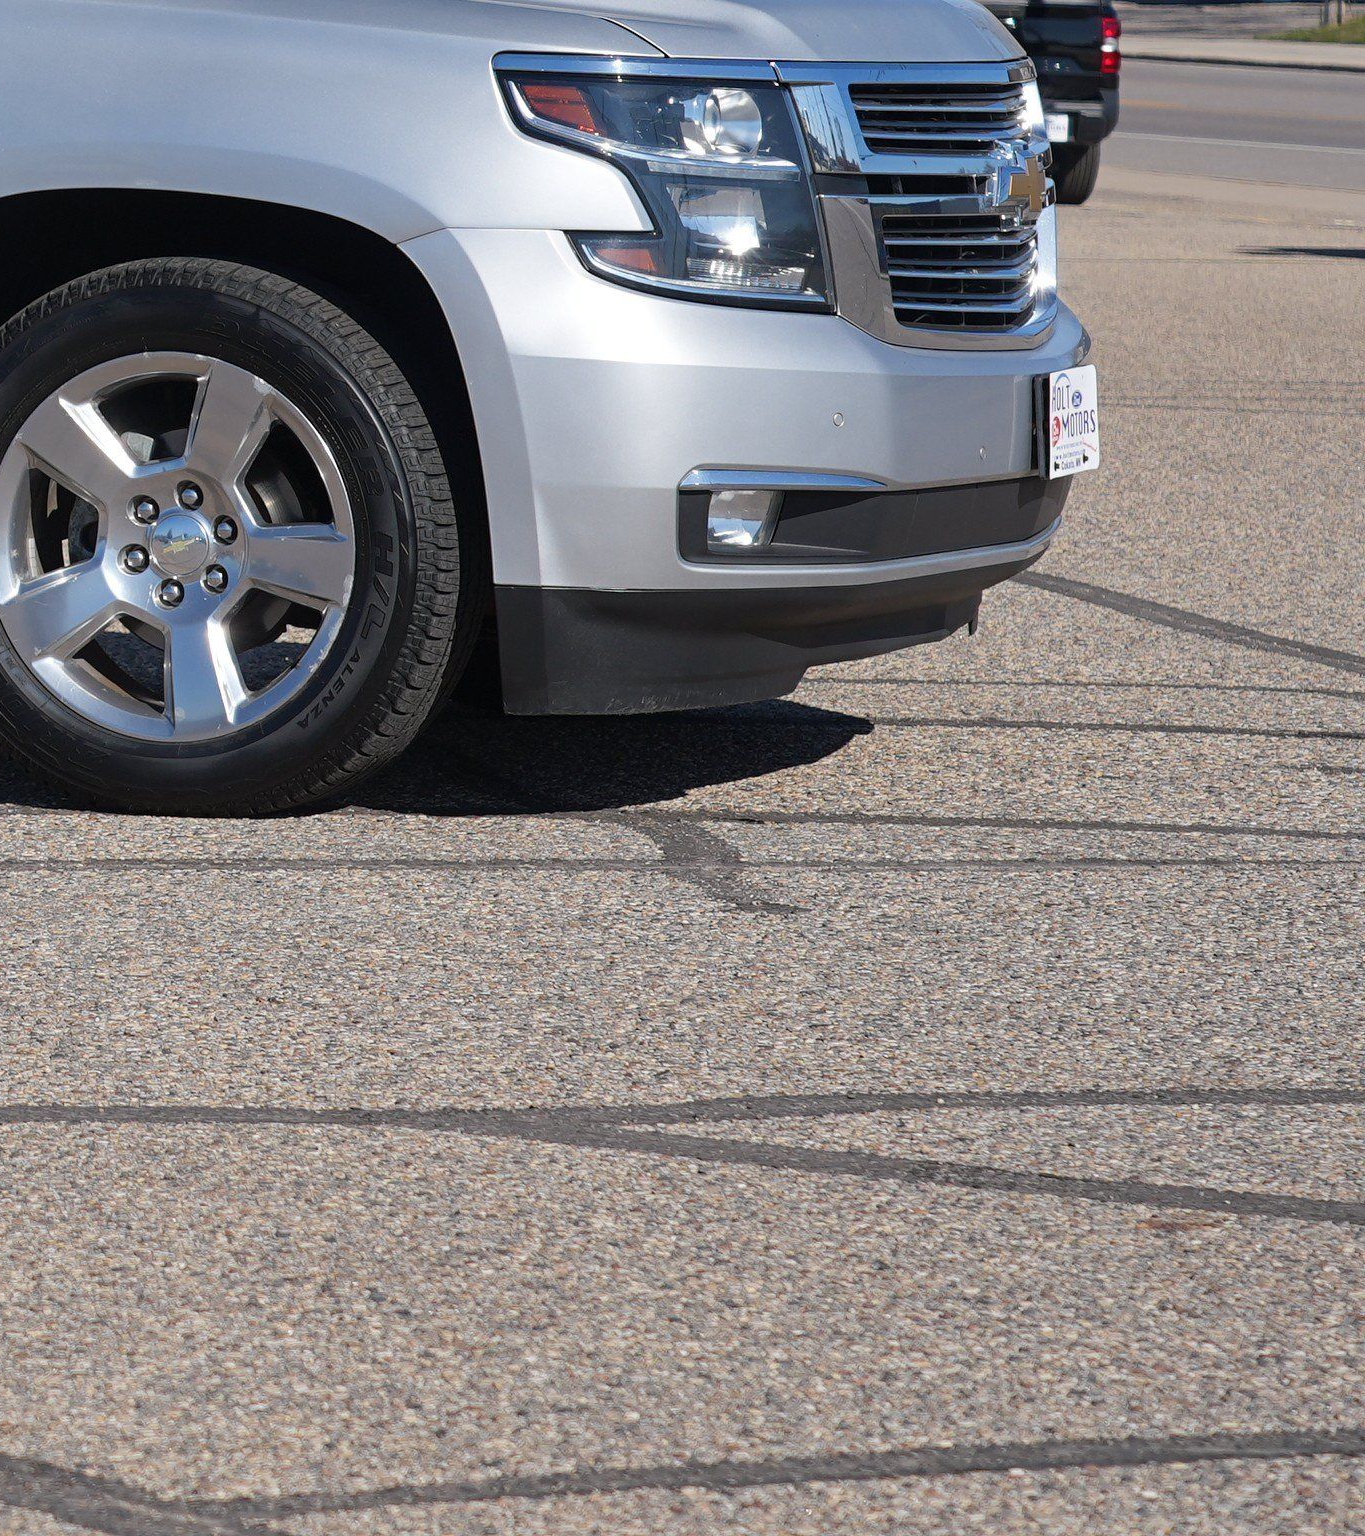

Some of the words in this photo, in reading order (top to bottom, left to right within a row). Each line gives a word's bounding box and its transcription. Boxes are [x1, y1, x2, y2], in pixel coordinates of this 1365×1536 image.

[1052, 384, 1070, 412] HOLT
[1062, 409, 1096, 439] MOTORS
[359, 530, 394, 641] H/L
[296, 645, 361, 730] ALENZA
